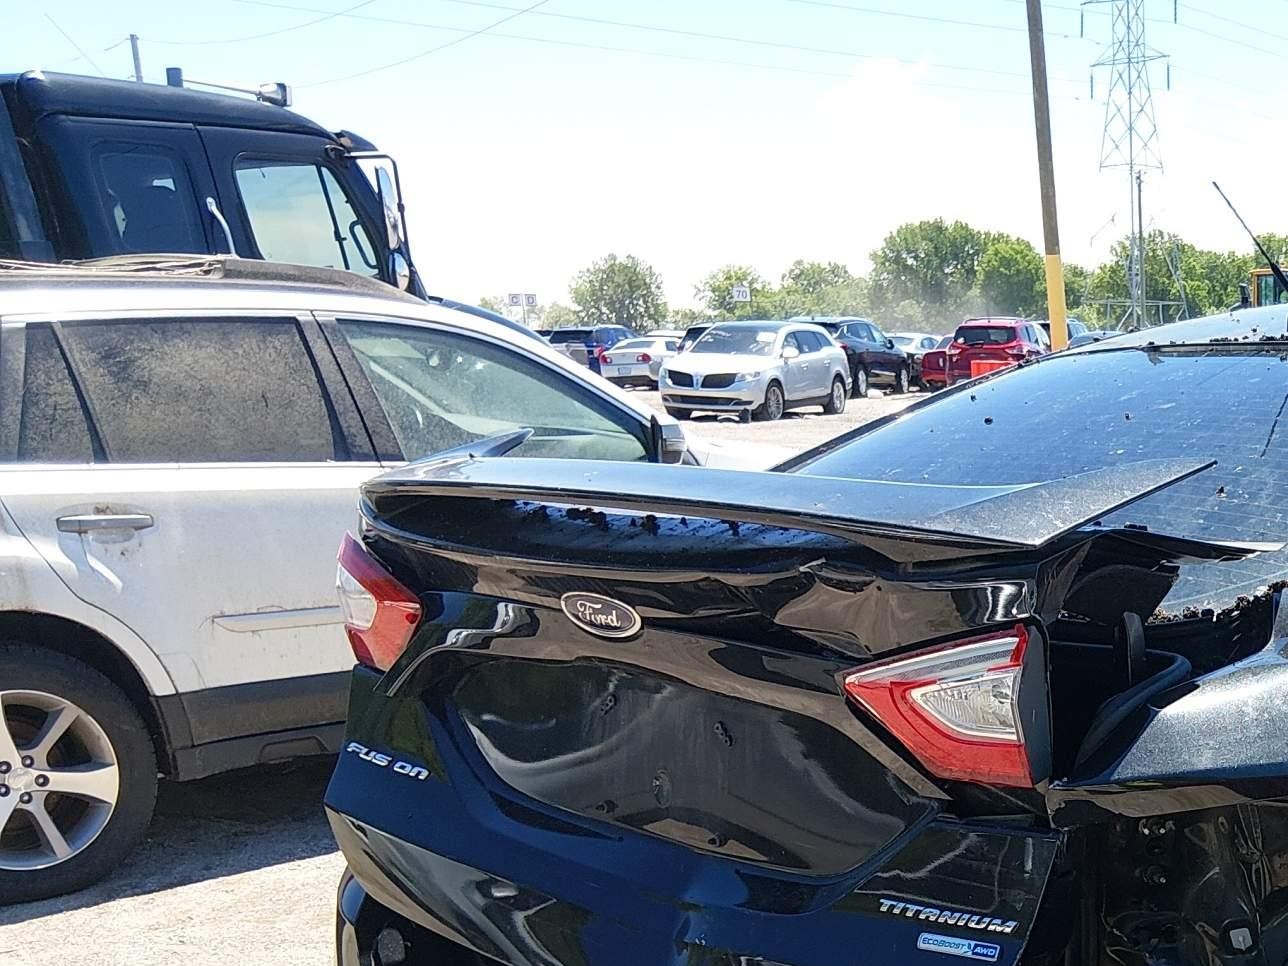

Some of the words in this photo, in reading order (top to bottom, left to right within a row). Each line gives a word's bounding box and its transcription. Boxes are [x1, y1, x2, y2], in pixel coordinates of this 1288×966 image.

[736, 289, 748, 299] 70
[576, 600, 621, 627] Ford
[879, 899, 1018, 934] TITANIUM
[973, 946, 996, 956] AWD
